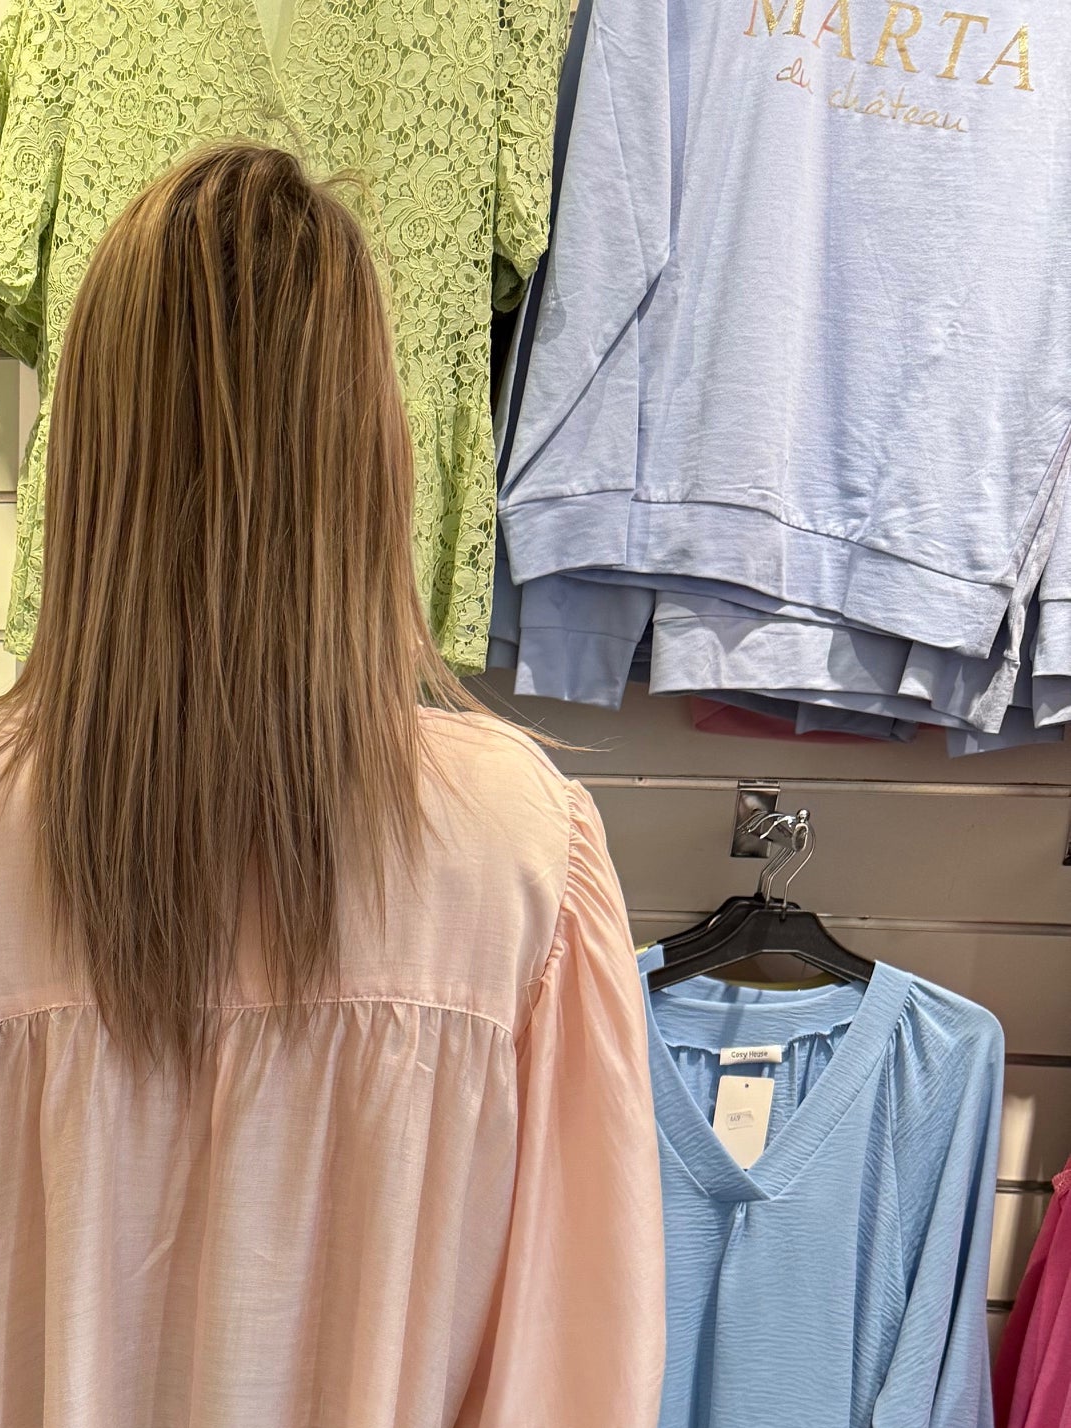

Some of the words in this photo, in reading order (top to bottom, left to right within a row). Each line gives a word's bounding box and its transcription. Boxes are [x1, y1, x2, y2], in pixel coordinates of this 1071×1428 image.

[743, 0, 1035, 92] MARTA
[776, 57, 814, 94] du
[829, 71, 968, 133] château
